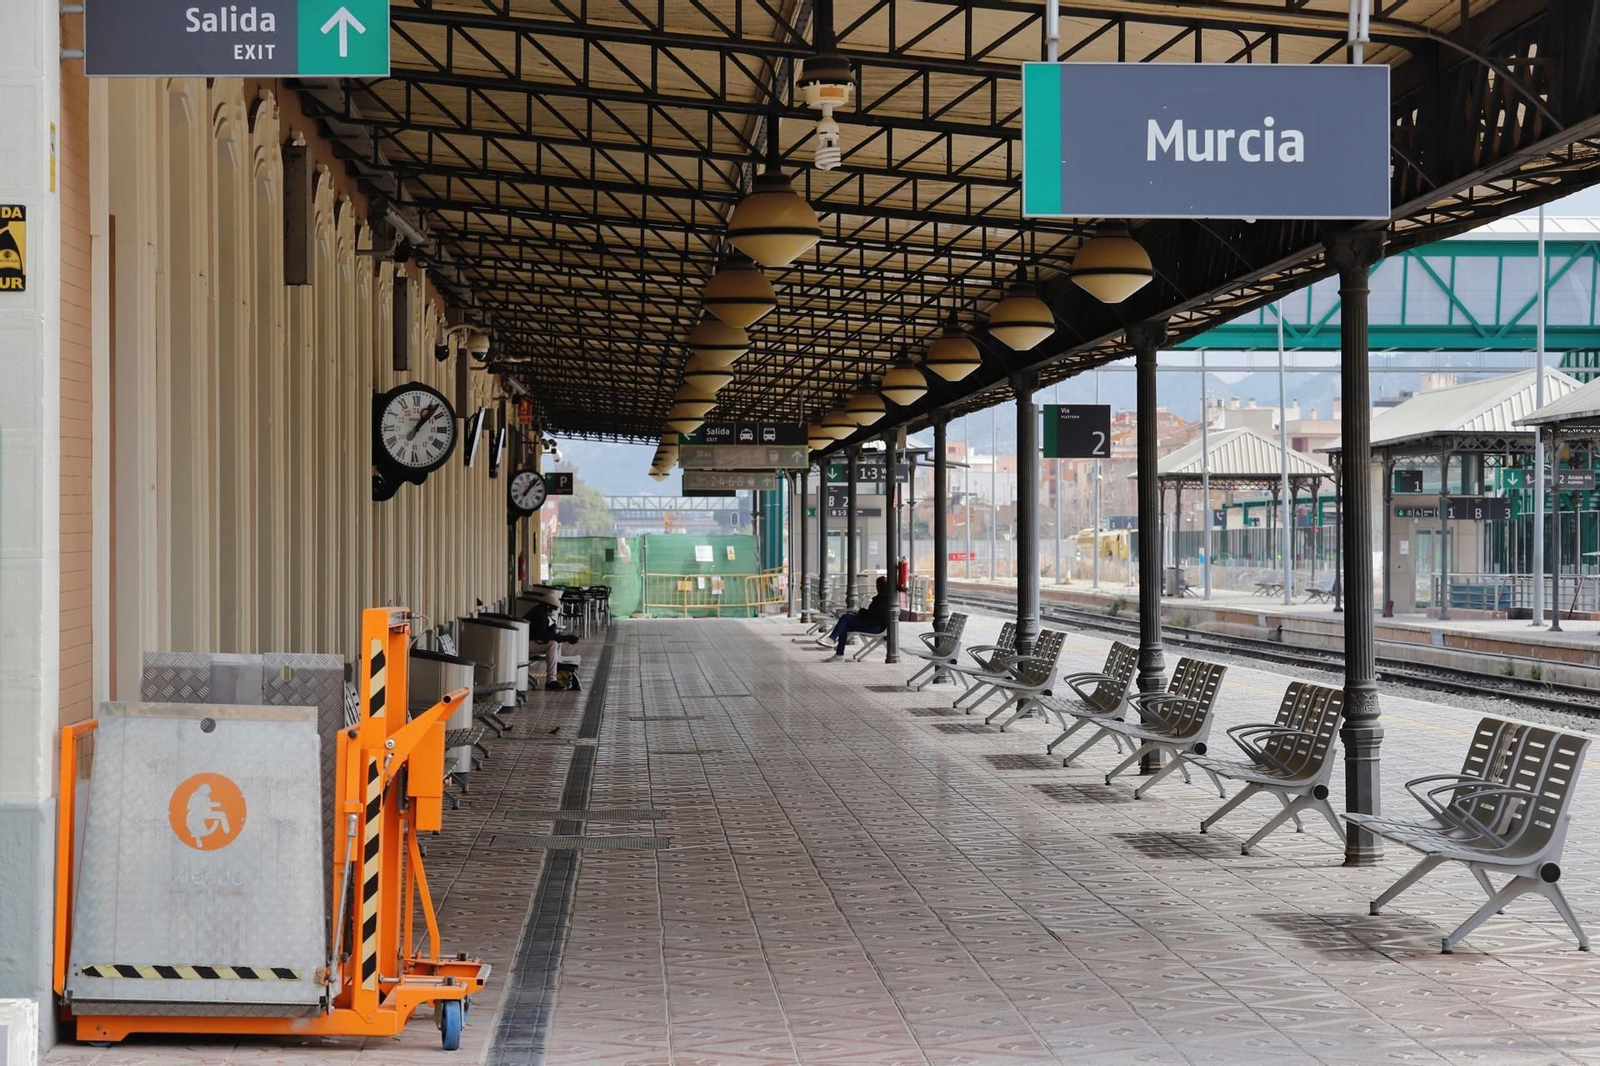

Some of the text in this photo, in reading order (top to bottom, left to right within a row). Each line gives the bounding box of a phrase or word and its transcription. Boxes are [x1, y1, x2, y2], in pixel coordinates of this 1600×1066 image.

[186, 5, 275, 32] Salida
[234, 44, 275, 60] EXIT
[1146, 115, 1304, 163] Murcia
[706, 427, 730, 436] Salida
[1092, 431, 1105, 455] 2
[560, 476, 568, 488] P
[1414, 481, 1421, 492] 1
[842, 496, 849, 507] 2
[1448, 508, 1511, 519] 1 B 3
